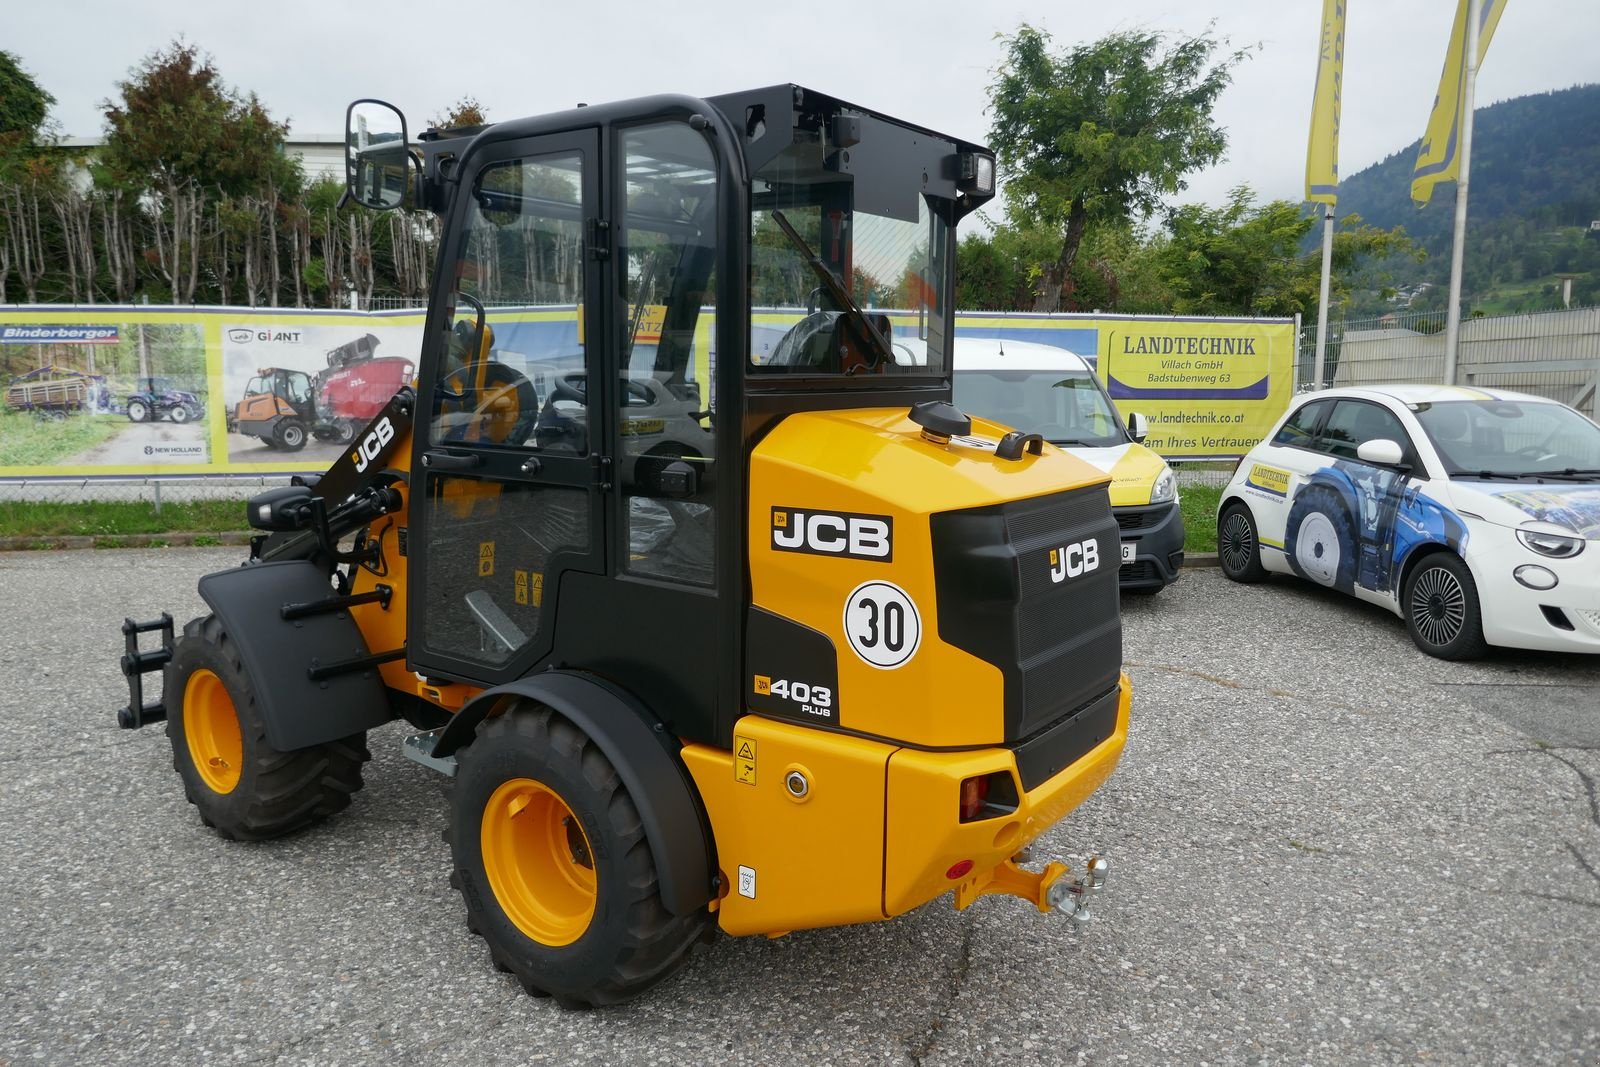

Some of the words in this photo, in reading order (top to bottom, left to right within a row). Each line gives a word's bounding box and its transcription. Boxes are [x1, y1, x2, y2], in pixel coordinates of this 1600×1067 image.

[3, 327, 116, 339] Binderberger
[1123, 336, 1256, 355] LANDTECHNIK
[1161, 360, 1192, 369] Villach
[1194, 360, 1224, 369] GmbH
[1147, 373, 1217, 384] Badstubenweg
[1219, 373, 1231, 382] 63
[1145, 411, 1245, 424] w.landtechnik.co.at
[355, 416, 395, 473] JCB
[1141, 439, 1164, 448] am
[1167, 436, 1197, 448] Ihres
[774, 513, 890, 557] JCB
[1050, 538, 1099, 583] JCB
[858, 597, 905, 652] 30
[770, 679, 832, 707] 403
[802, 704, 831, 717] PLUS
